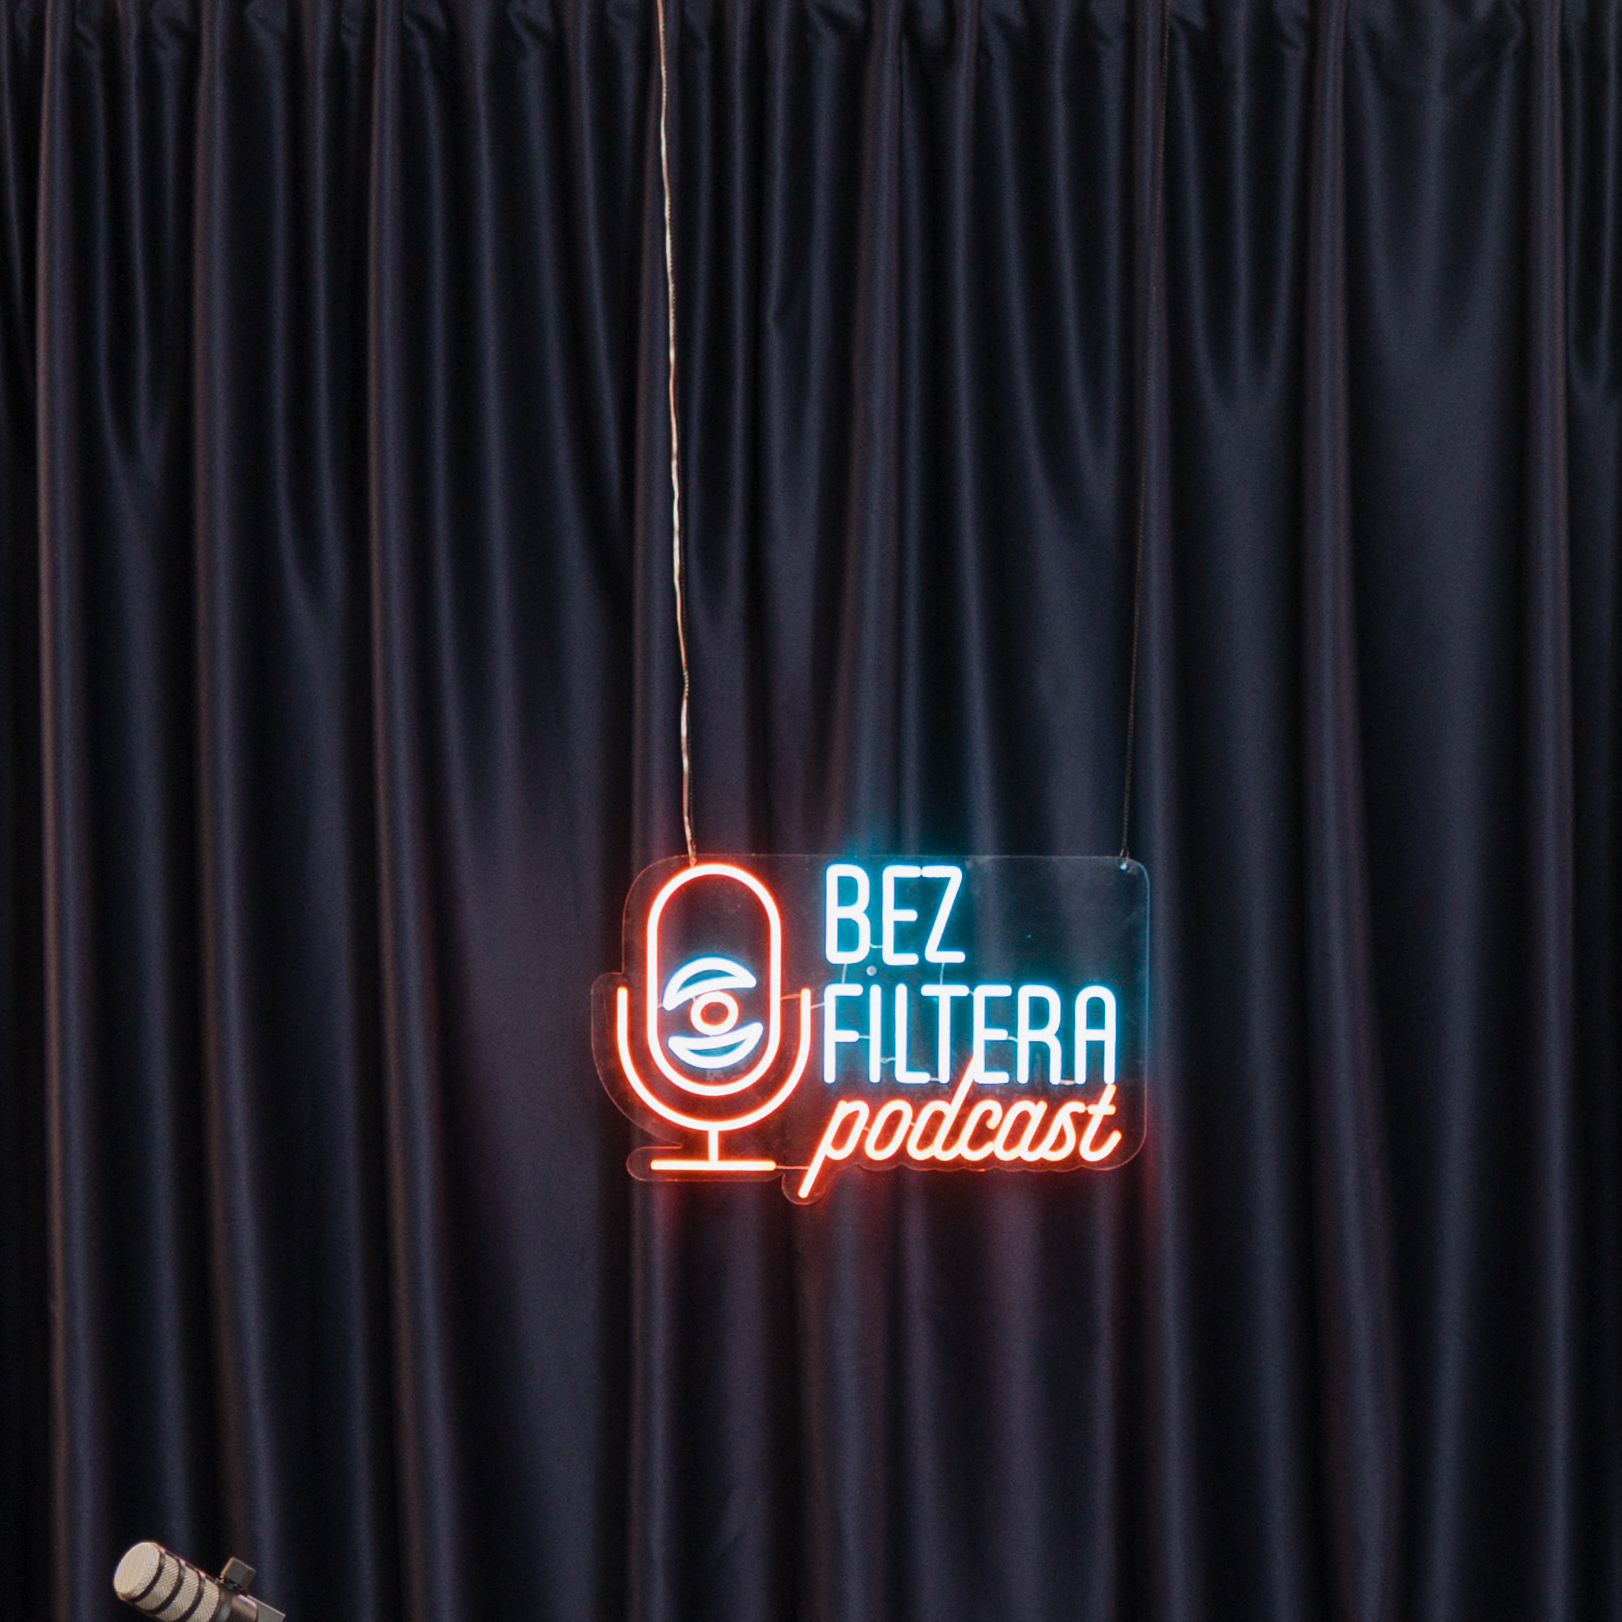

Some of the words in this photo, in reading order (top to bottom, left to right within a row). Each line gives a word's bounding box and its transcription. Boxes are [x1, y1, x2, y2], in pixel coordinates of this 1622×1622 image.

[824, 863, 966, 966] BEZ
[823, 984, 1117, 1085] FILTERA
[797, 1052, 1122, 1199] podcast
